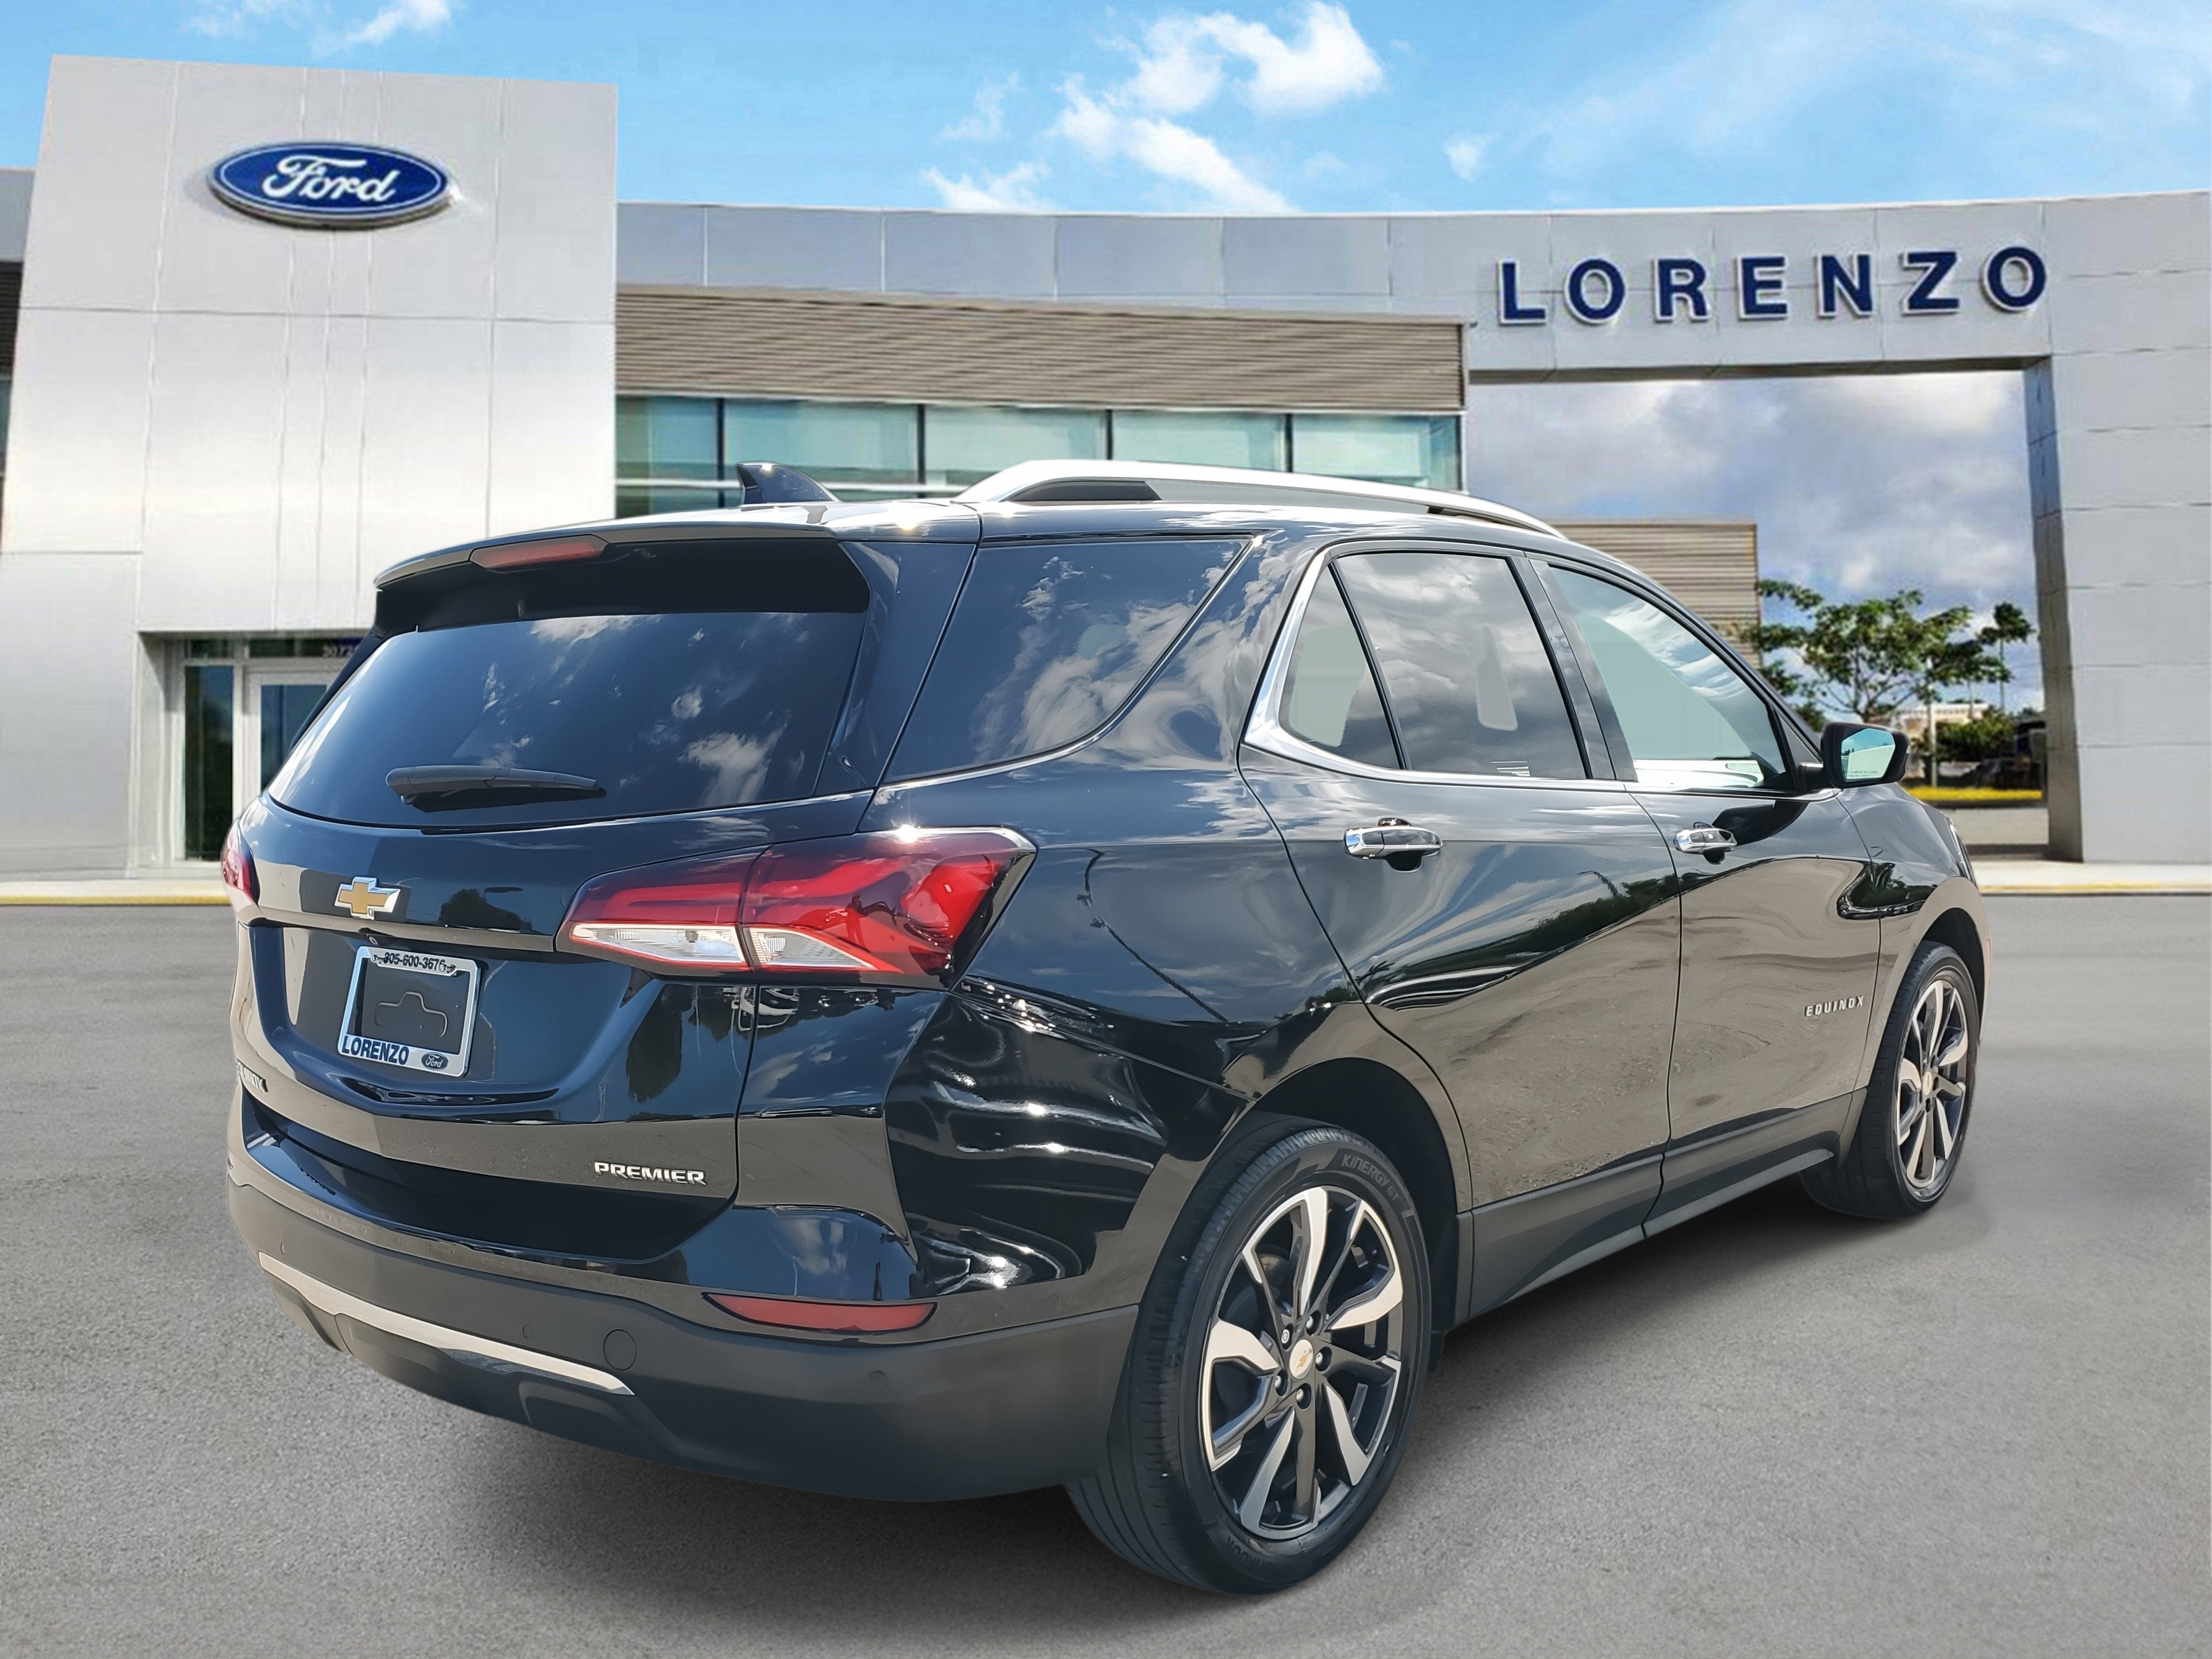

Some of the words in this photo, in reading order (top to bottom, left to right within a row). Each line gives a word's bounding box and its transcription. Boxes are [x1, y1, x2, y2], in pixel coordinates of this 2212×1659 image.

[262, 154, 400, 201] Ford
[1498, 246, 2046, 325] LORENZO
[1804, 995, 1864, 1016] EQUINOX
[341, 1035, 409, 1065] LORENZO
[425, 1054, 444, 1068] Ford
[594, 1161, 708, 1186] PREMIER
[1341, 1154, 1389, 1186] KINERGY
